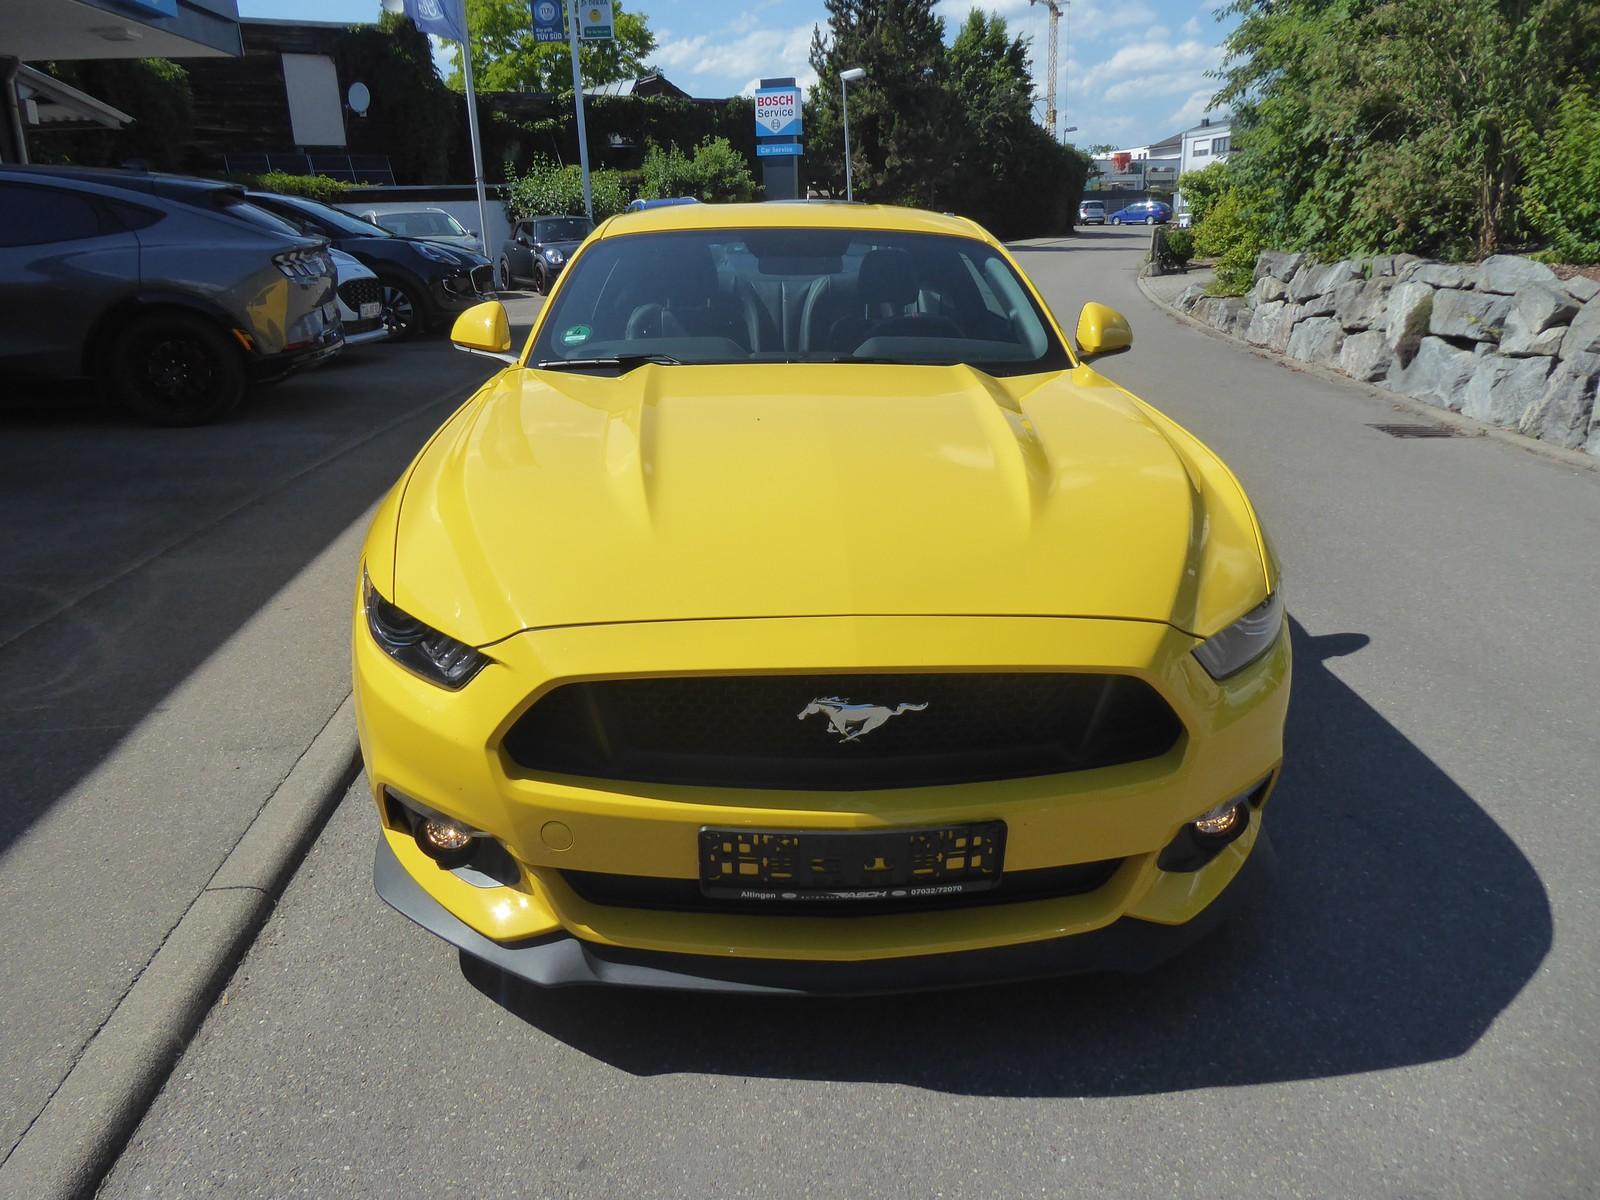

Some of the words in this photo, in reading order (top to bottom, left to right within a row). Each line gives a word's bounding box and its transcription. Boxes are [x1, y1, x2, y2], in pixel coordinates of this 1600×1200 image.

[757, 95, 793, 107] BOSCH
[758, 107, 794, 118] Service
[740, 891, 776, 900] Altingen
[911, 885, 962, 896] 07032/72070
